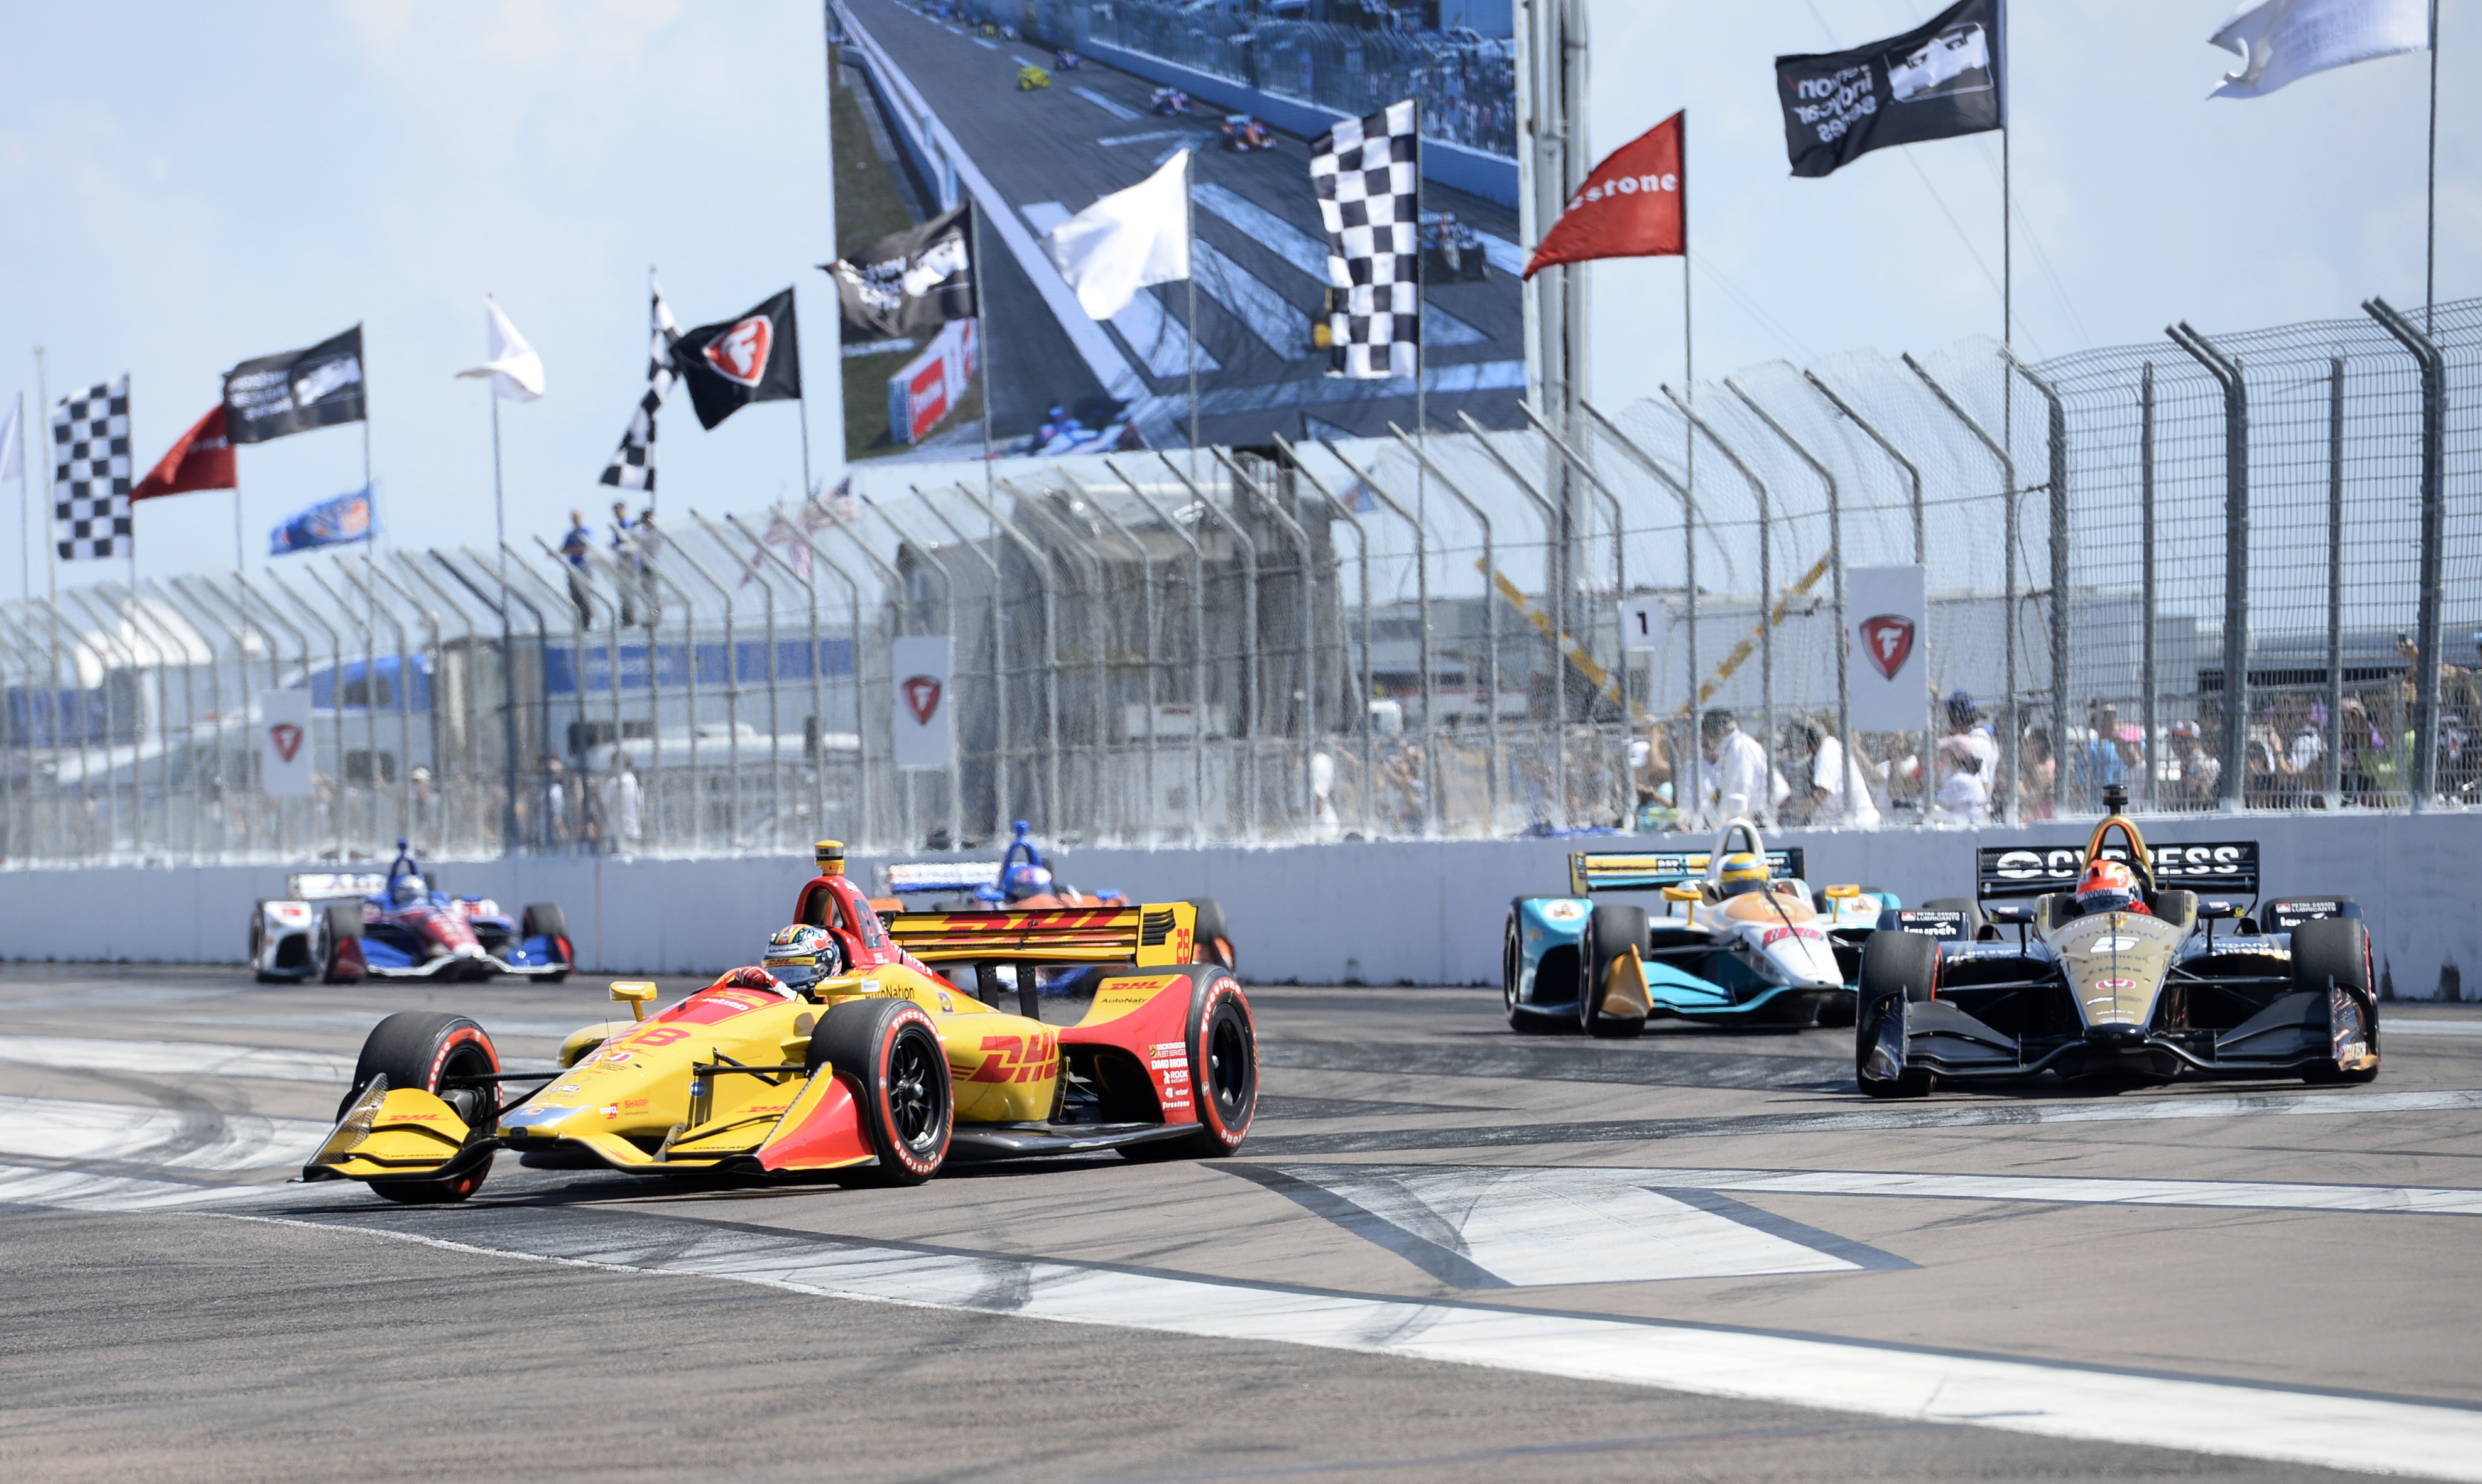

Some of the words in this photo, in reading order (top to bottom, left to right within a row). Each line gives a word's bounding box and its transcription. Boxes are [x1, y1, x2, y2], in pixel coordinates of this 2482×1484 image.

[1565, 173, 1678, 214] estone
[1636, 610, 1648, 636] 1
[1877, 627, 1903, 661] F
[2048, 847, 2239, 878] CPESS
[1176, 928, 1190, 965] 28
[2089, 936, 2140, 953] 5
[1109, 981, 1160, 990] DHL
[1202, 979, 1241, 1032] Firestone
[892, 1010, 942, 1043] Firestone
[968, 1031, 1059, 1083] DHL
[1151, 1059, 1169, 1070] DMG
[1170, 1058, 1188, 1068] MORI
[1170, 1070, 1189, 1078] ROOK
[624, 1099, 648, 1108] SHARP
[1162, 1101, 1190, 1111] Firestone
[894, 1139, 942, 1173] Firestone
